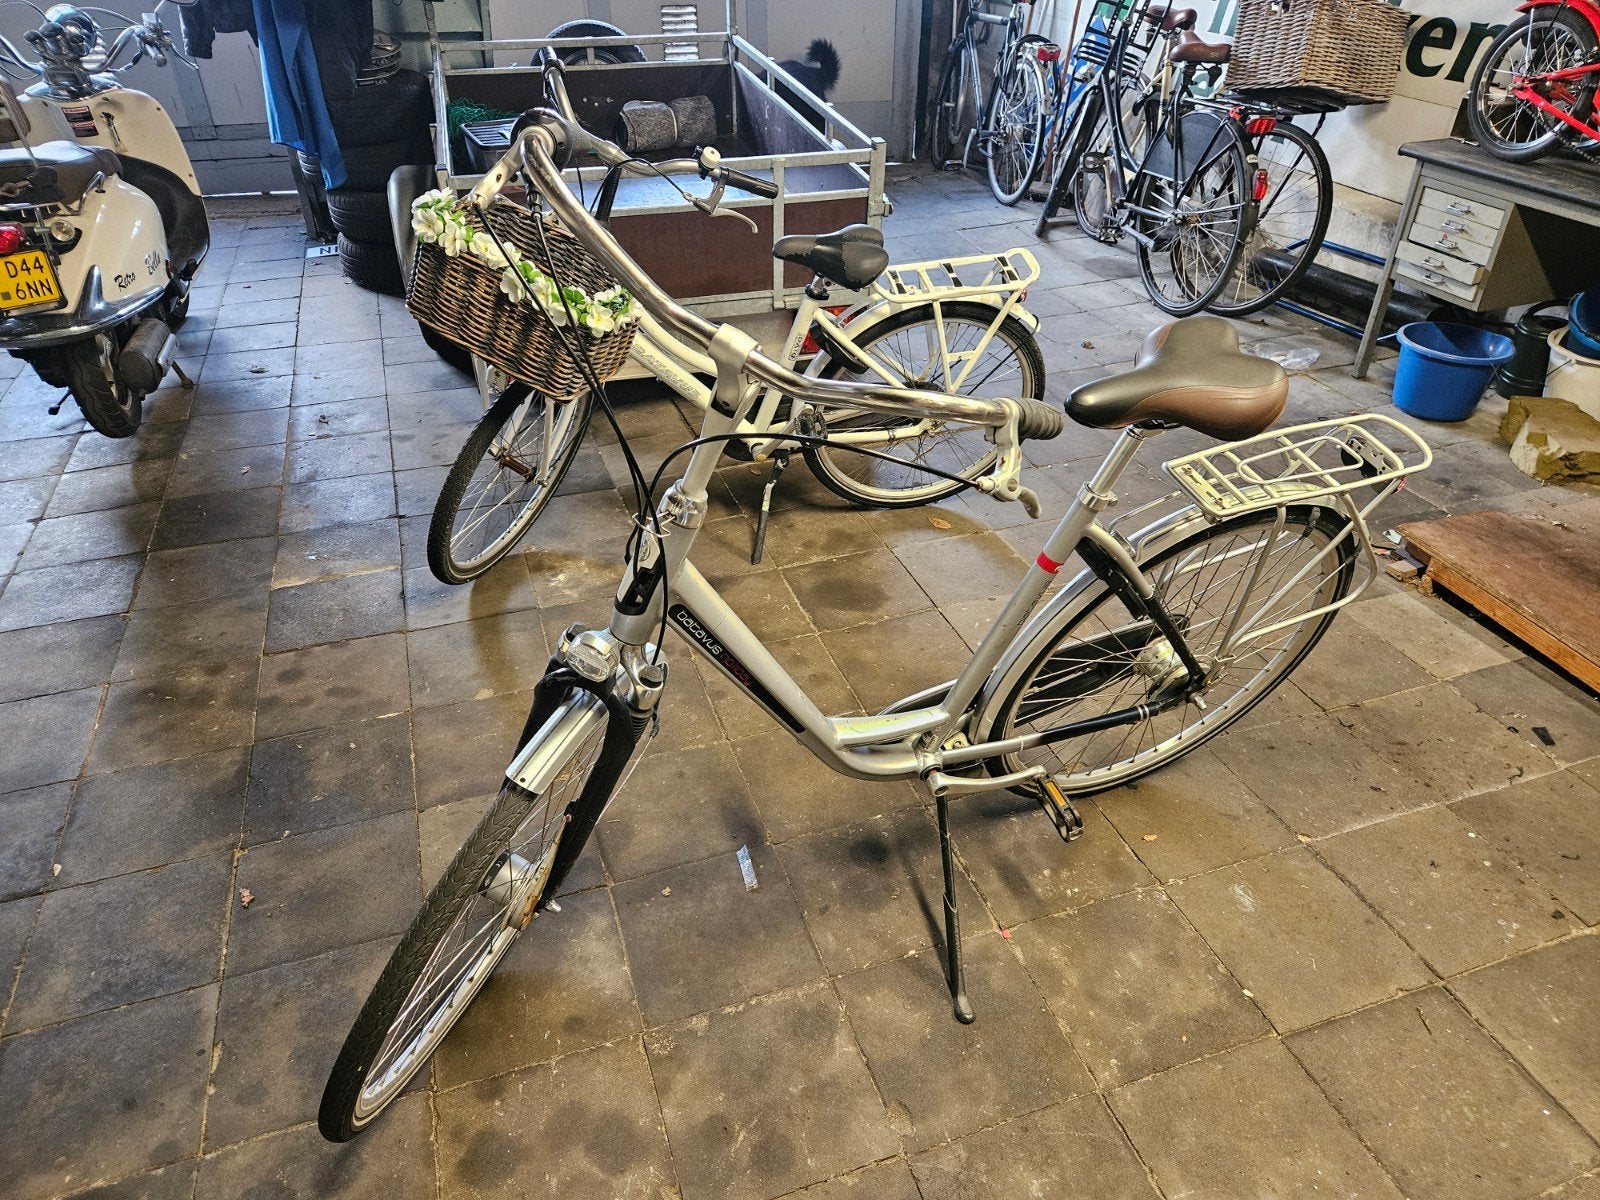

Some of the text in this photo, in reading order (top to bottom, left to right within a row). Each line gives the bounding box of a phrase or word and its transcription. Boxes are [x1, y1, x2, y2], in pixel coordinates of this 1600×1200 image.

[4, 256, 44, 279] D44
[15, 279, 54, 300] 6NN
[114, 272, 136, 292] Retro
[676, 610, 723, 655] batavus
